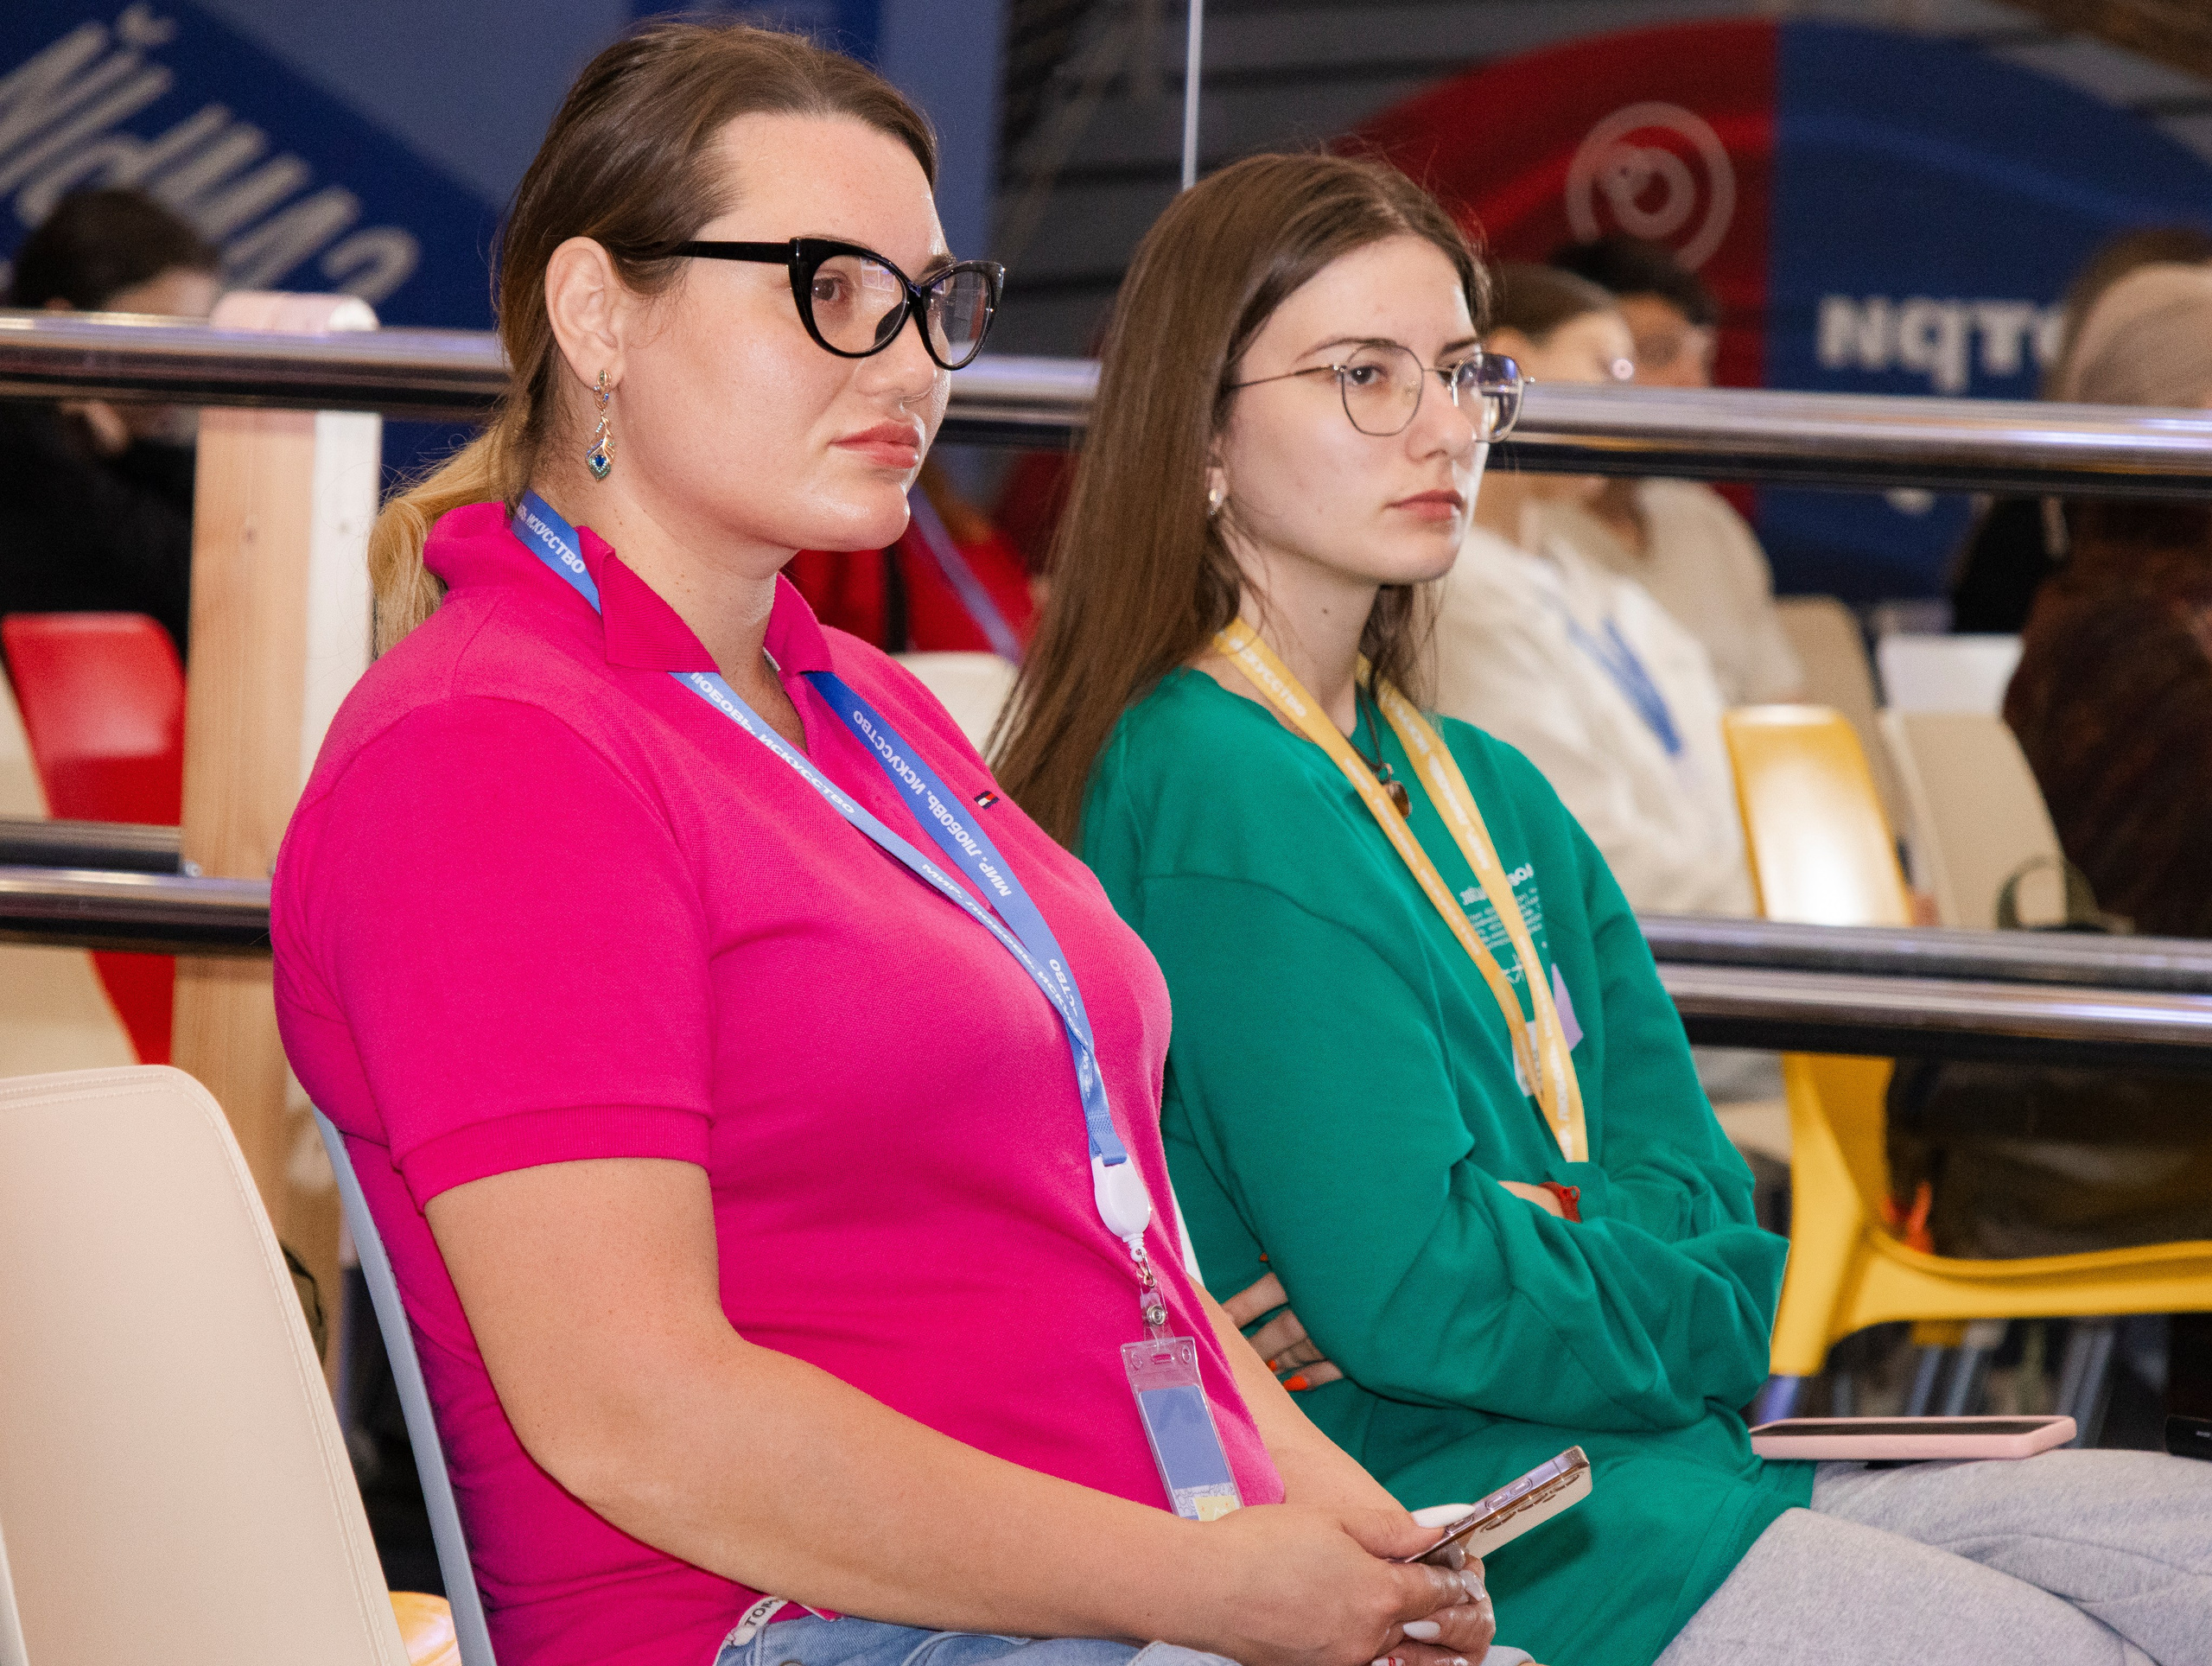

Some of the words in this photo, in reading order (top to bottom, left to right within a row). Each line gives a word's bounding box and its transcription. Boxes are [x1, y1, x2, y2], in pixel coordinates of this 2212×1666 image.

[525, 513, 586, 574] ИСКУССТВО
[758, 734, 855, 814] ИСКУССТВО
[853, 710, 926, 795] ИСКУССТВО
